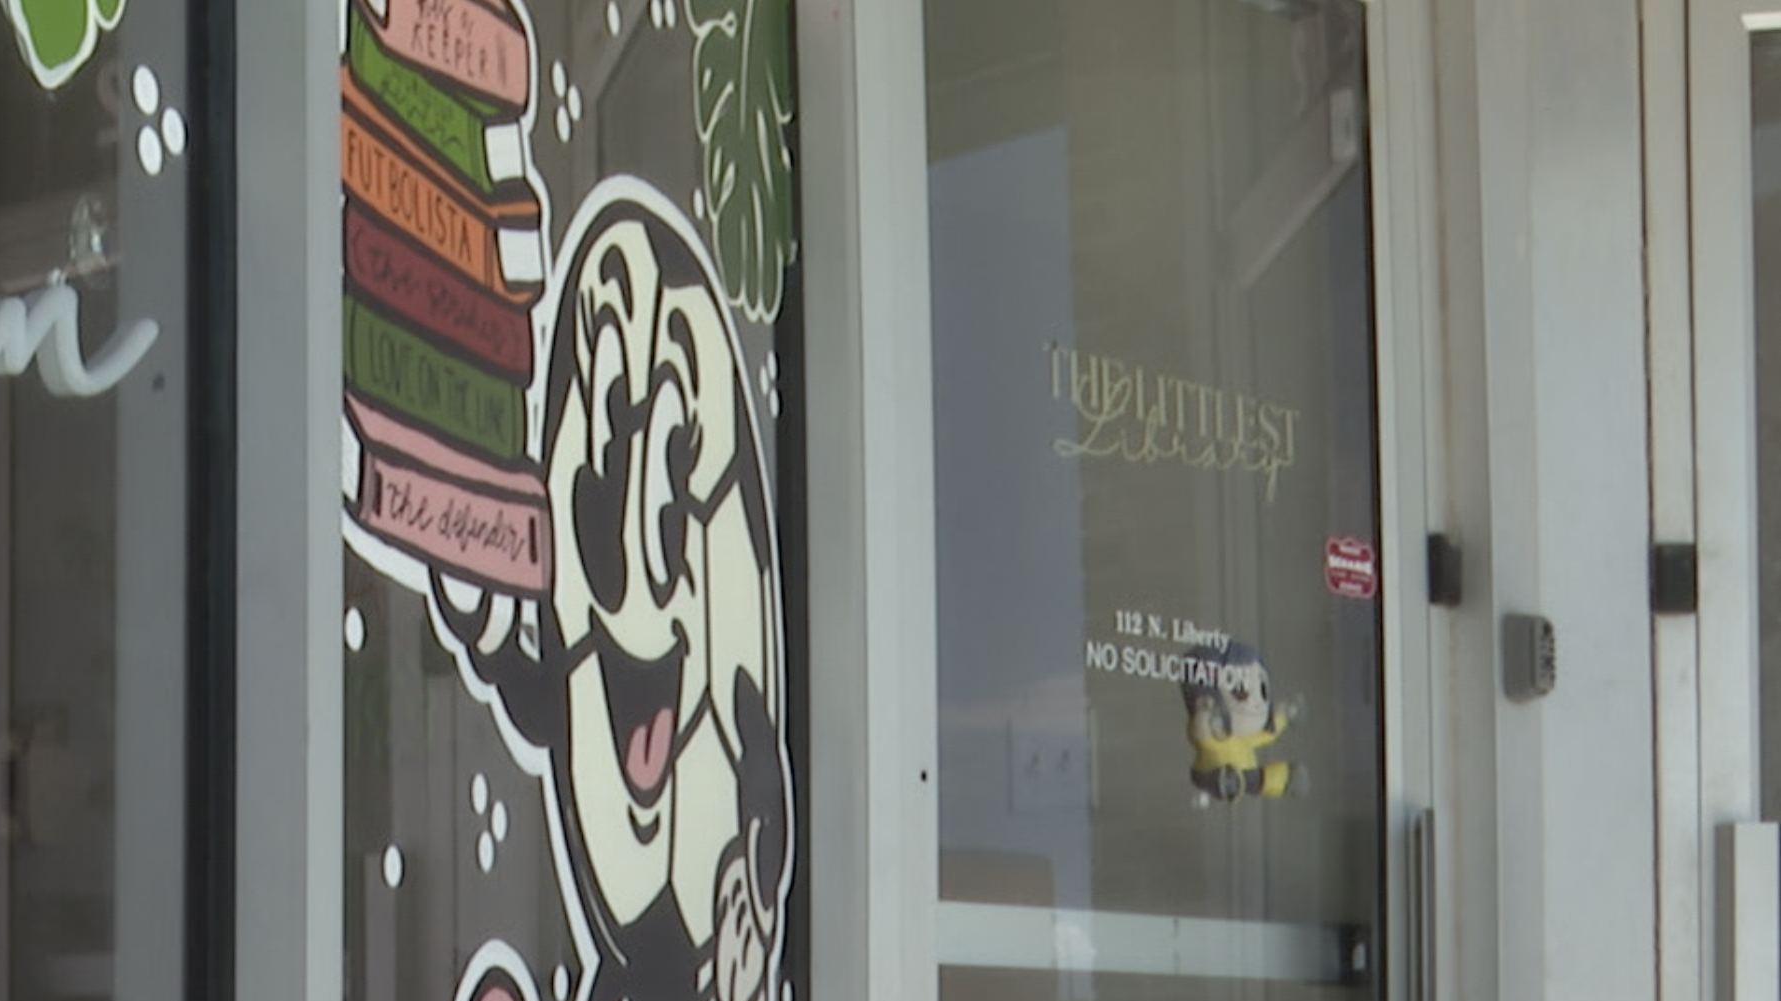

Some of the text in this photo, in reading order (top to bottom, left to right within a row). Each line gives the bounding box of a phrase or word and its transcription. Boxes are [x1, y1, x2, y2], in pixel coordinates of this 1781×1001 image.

[347, 128, 472, 264] FUTBOLISTA
[1134, 366, 1300, 466] LITTLEST
[386, 481, 525, 562] the defender
[1086, 640, 1118, 672] NO
[1115, 610, 1231, 653] 112 N. Liberty
